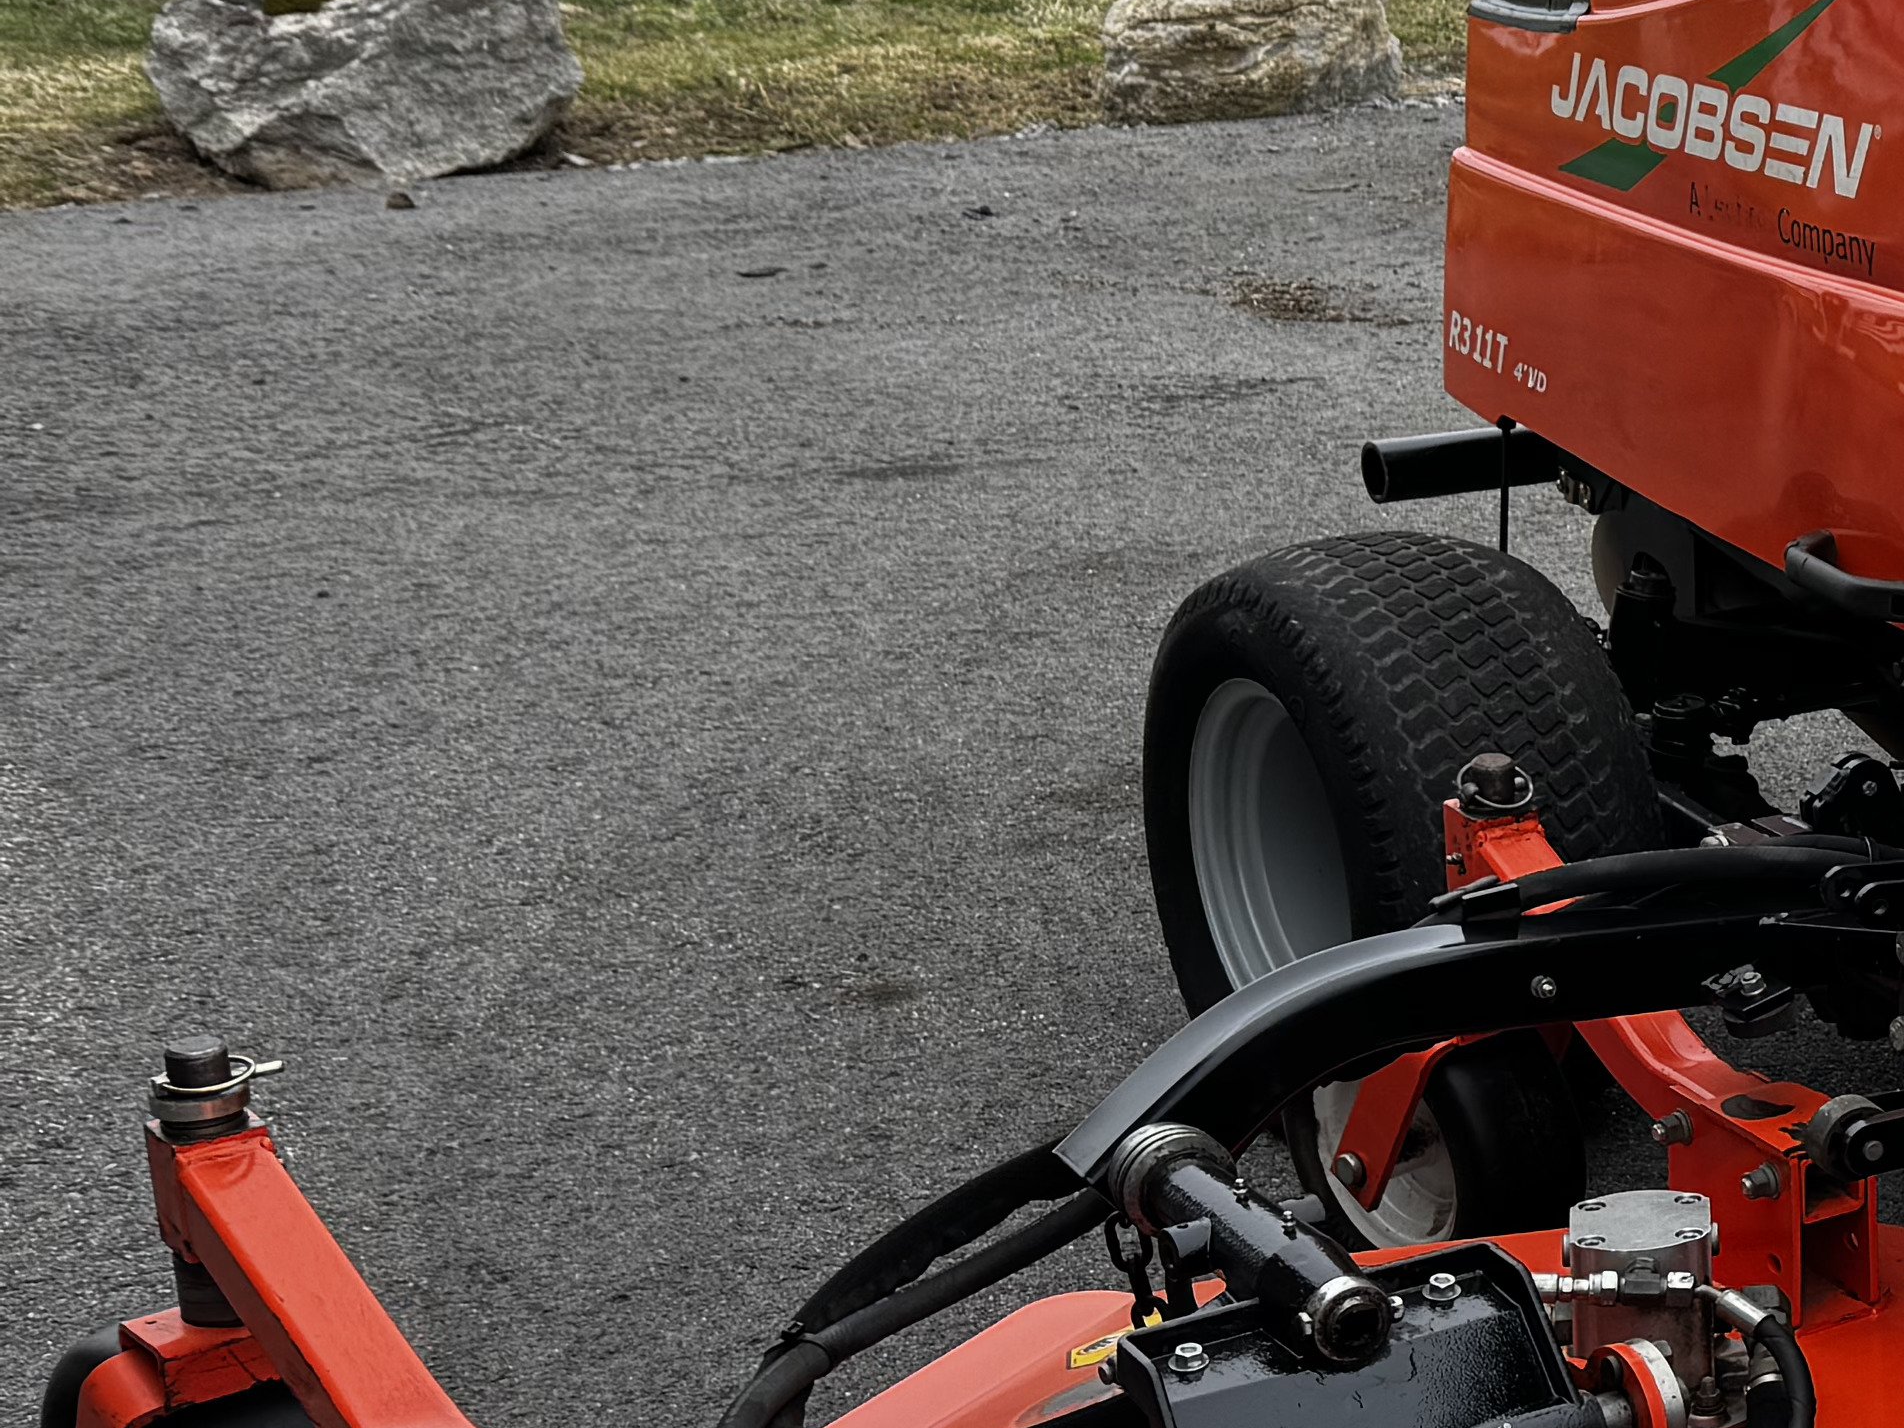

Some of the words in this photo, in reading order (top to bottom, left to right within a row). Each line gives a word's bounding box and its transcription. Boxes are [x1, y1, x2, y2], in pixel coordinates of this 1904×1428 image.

[1551, 52, 1873, 199] JACOBSEN
[1777, 207, 1876, 277] Company
[1449, 310, 1509, 374] R311T
